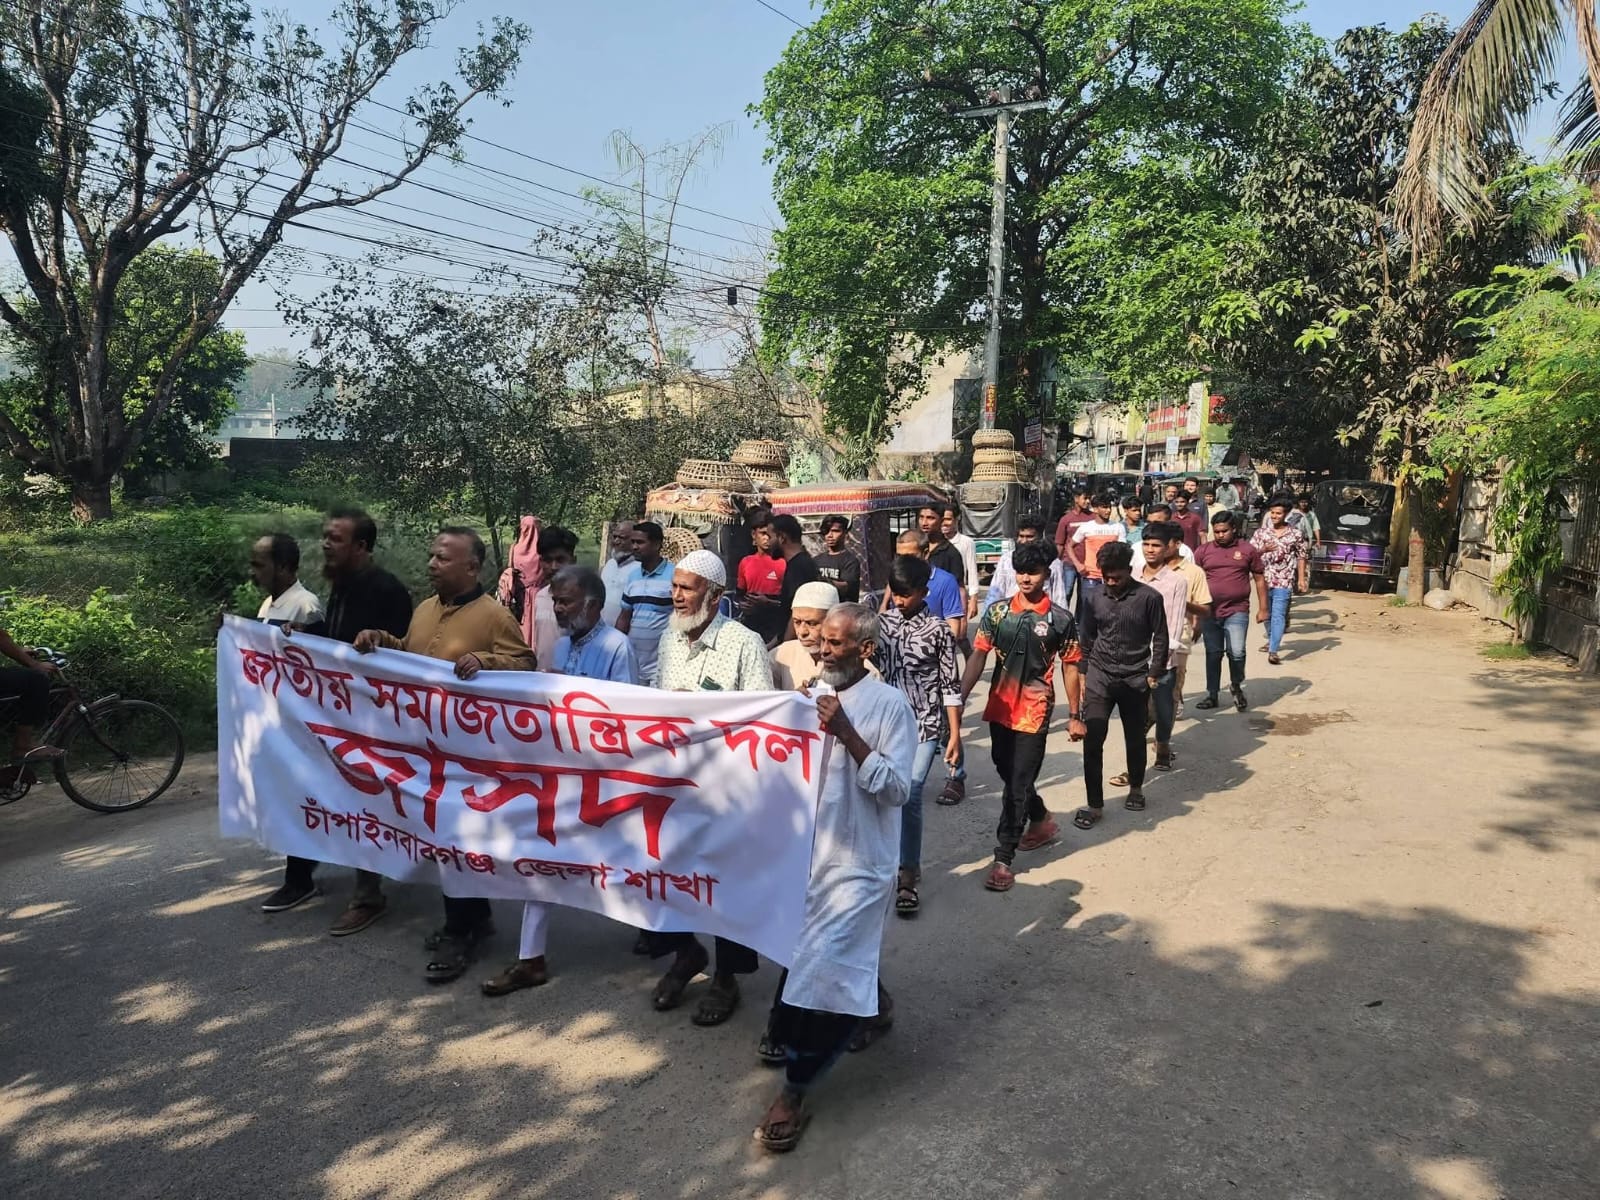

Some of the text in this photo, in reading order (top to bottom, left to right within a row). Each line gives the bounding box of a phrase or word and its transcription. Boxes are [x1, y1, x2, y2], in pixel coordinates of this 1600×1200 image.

[239, 645, 821, 783] জাতীয় সমাজতান্ত্রিক দল
[300, 797, 720, 906] চাঁপাইনবাবগঞ্জ জেলা শাখা
[304, 721, 699, 861] জাসদ
